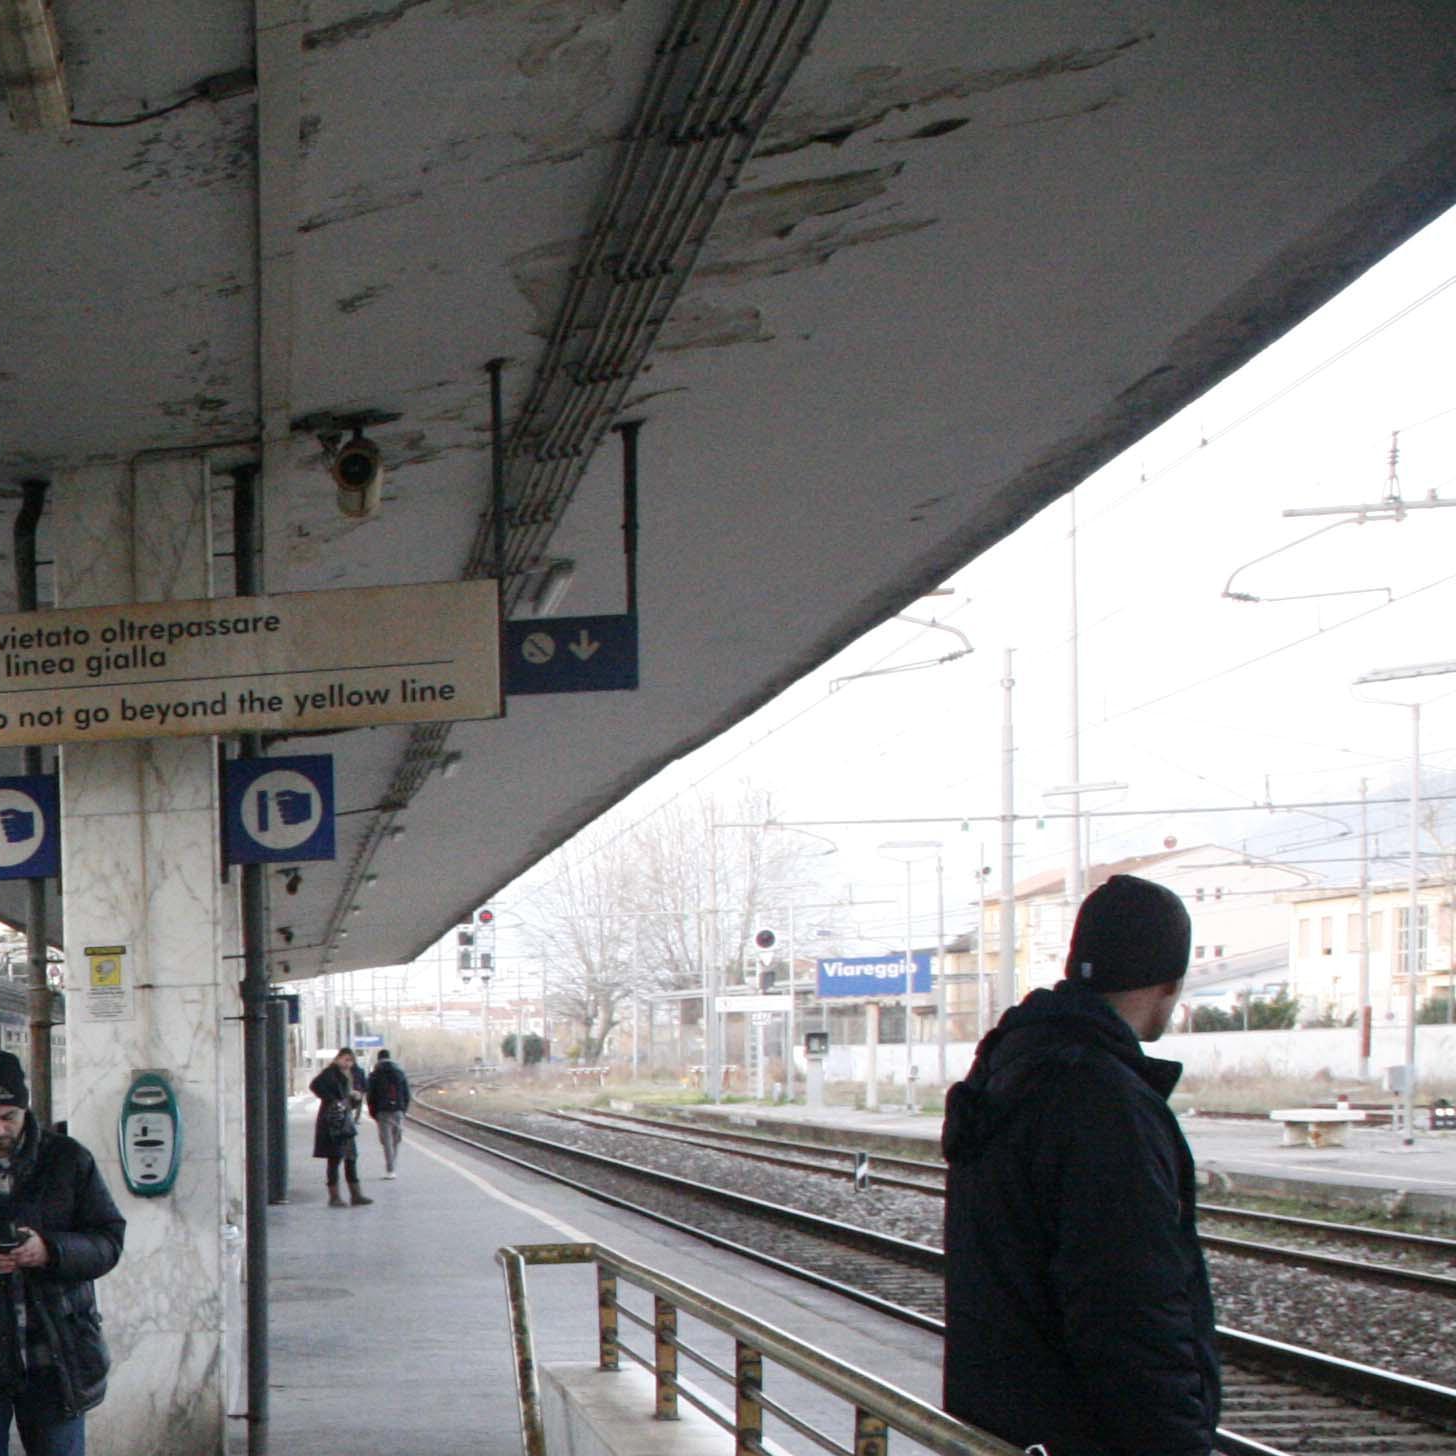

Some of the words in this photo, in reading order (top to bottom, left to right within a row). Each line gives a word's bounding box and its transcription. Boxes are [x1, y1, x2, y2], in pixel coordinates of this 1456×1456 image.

[100, 615, 281, 645] oltrepassare
[6, 653, 75, 677] linea
[85, 646, 167, 677] gialla
[19, 706, 64, 728] not
[74, 706, 109, 731] go
[121, 691, 228, 725] beyond
[239, 690, 283, 714] the
[293, 683, 390, 716] yellow
[401, 677, 456, 704] line
[823, 959, 918, 979] Viareggio
